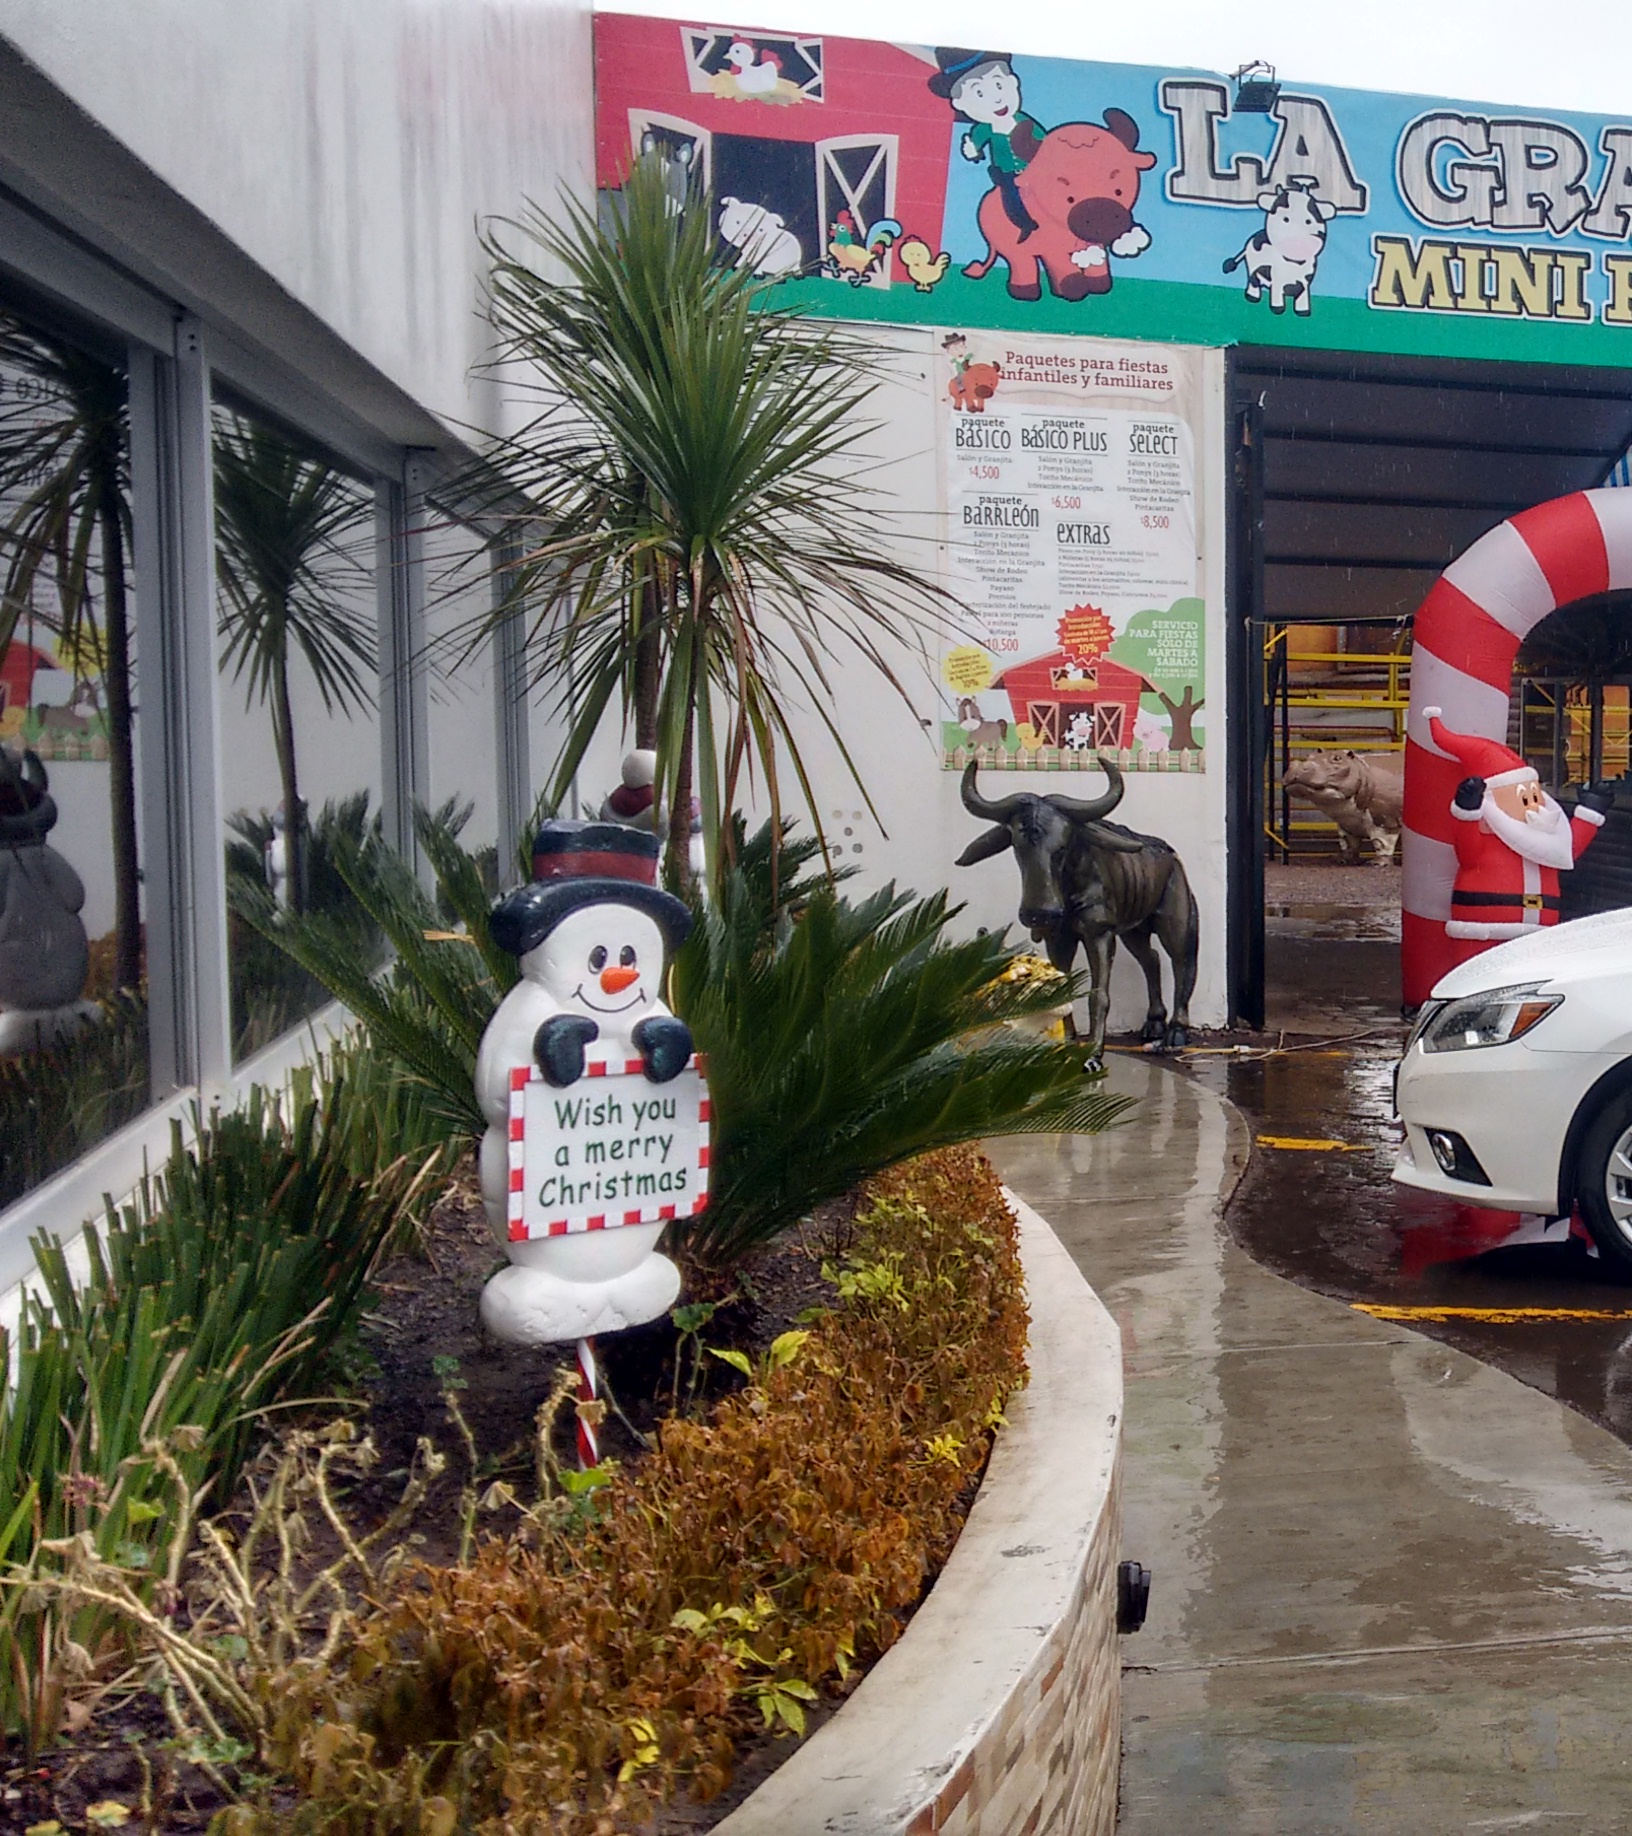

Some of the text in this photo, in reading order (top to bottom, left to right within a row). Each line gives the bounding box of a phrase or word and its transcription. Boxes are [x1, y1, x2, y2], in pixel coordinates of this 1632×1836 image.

[1160, 80, 1368, 213] LA
[1370, 236, 1593, 321] MINI
[1005, 351, 1168, 374] Paquetes para fiestas
[1000, 368, 1174, 390] infantiles y familiares
[961, 418, 1005, 429] paquete
[1042, 419, 1085, 430] paquete
[1133, 424, 1174, 435] paquete
[1073, 431, 1108, 452] PLUS
[979, 496, 1022, 506] paquete
[1152, 620, 1198, 630] SERVICIO
[1129, 629, 1198, 639] PARA FIESTAS
[1078, 643, 1098, 655] 20%
[1184, 640, 1198, 648] DE
[1147, 648, 1198, 658] MARTES A
[554, 1094, 676, 1131] Wish you
[555, 1134, 674, 1167] a merry
[538, 1167, 687, 1208] Christmas
